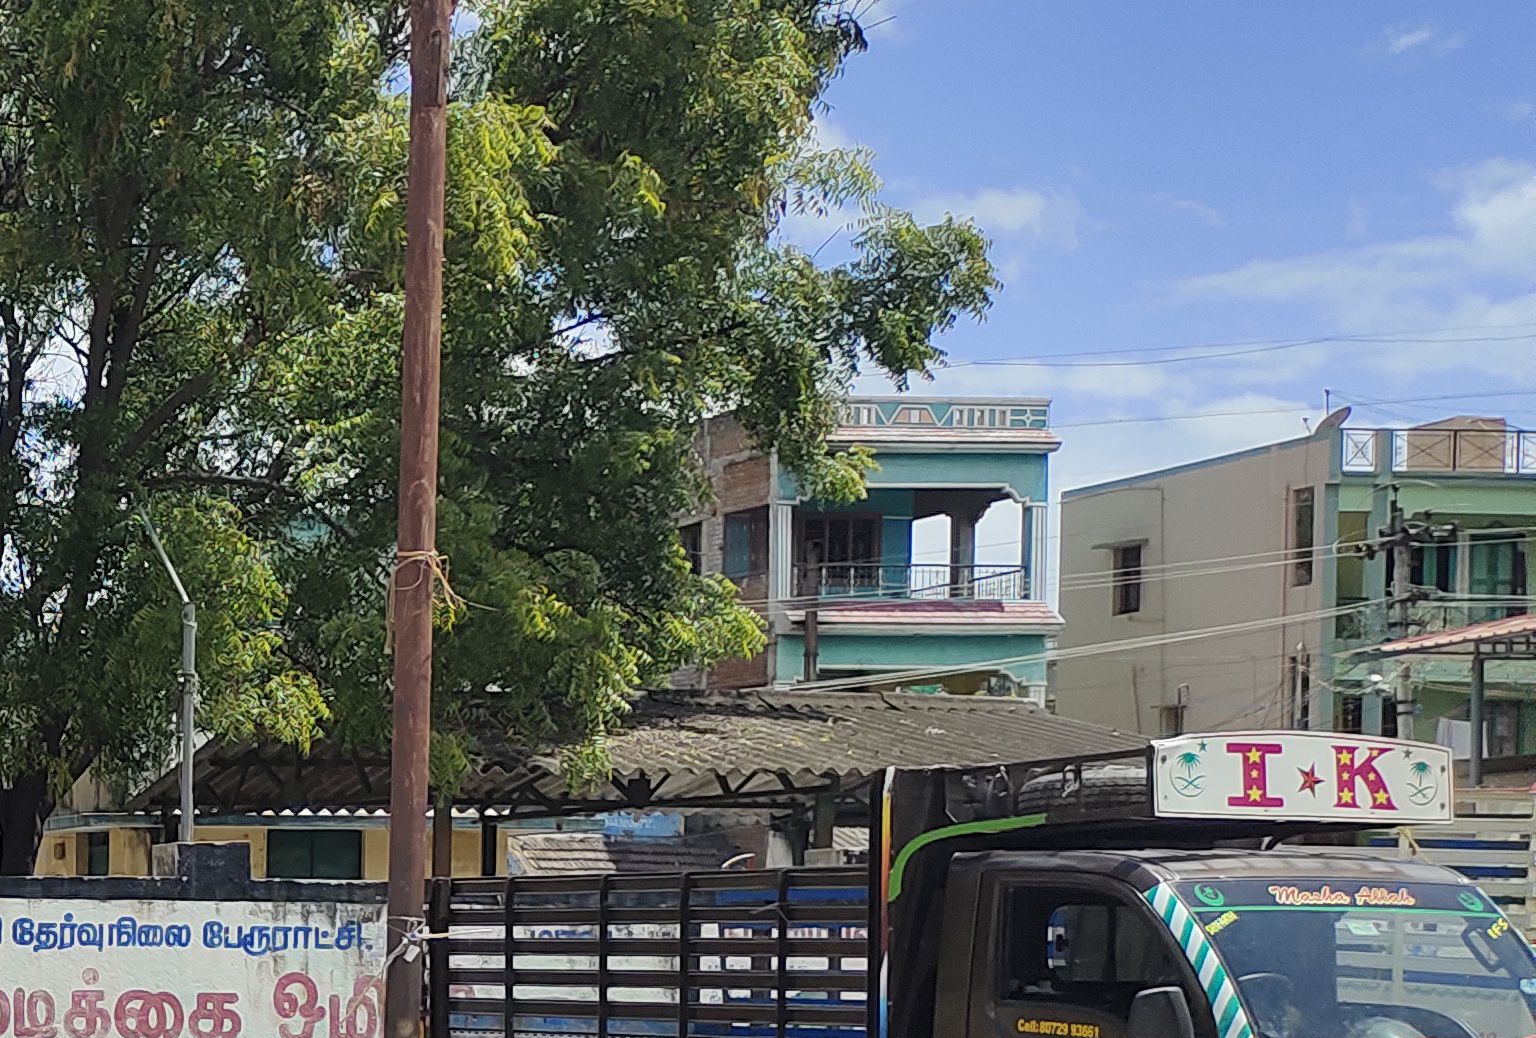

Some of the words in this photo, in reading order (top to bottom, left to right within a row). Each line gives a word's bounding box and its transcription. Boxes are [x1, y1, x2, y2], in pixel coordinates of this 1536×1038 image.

[1226, 742, 1285, 808] I
[1331, 744, 1399, 811] K
[1268, 885, 1351, 906] Masha
[1354, 885, 1416, 906] Allah
